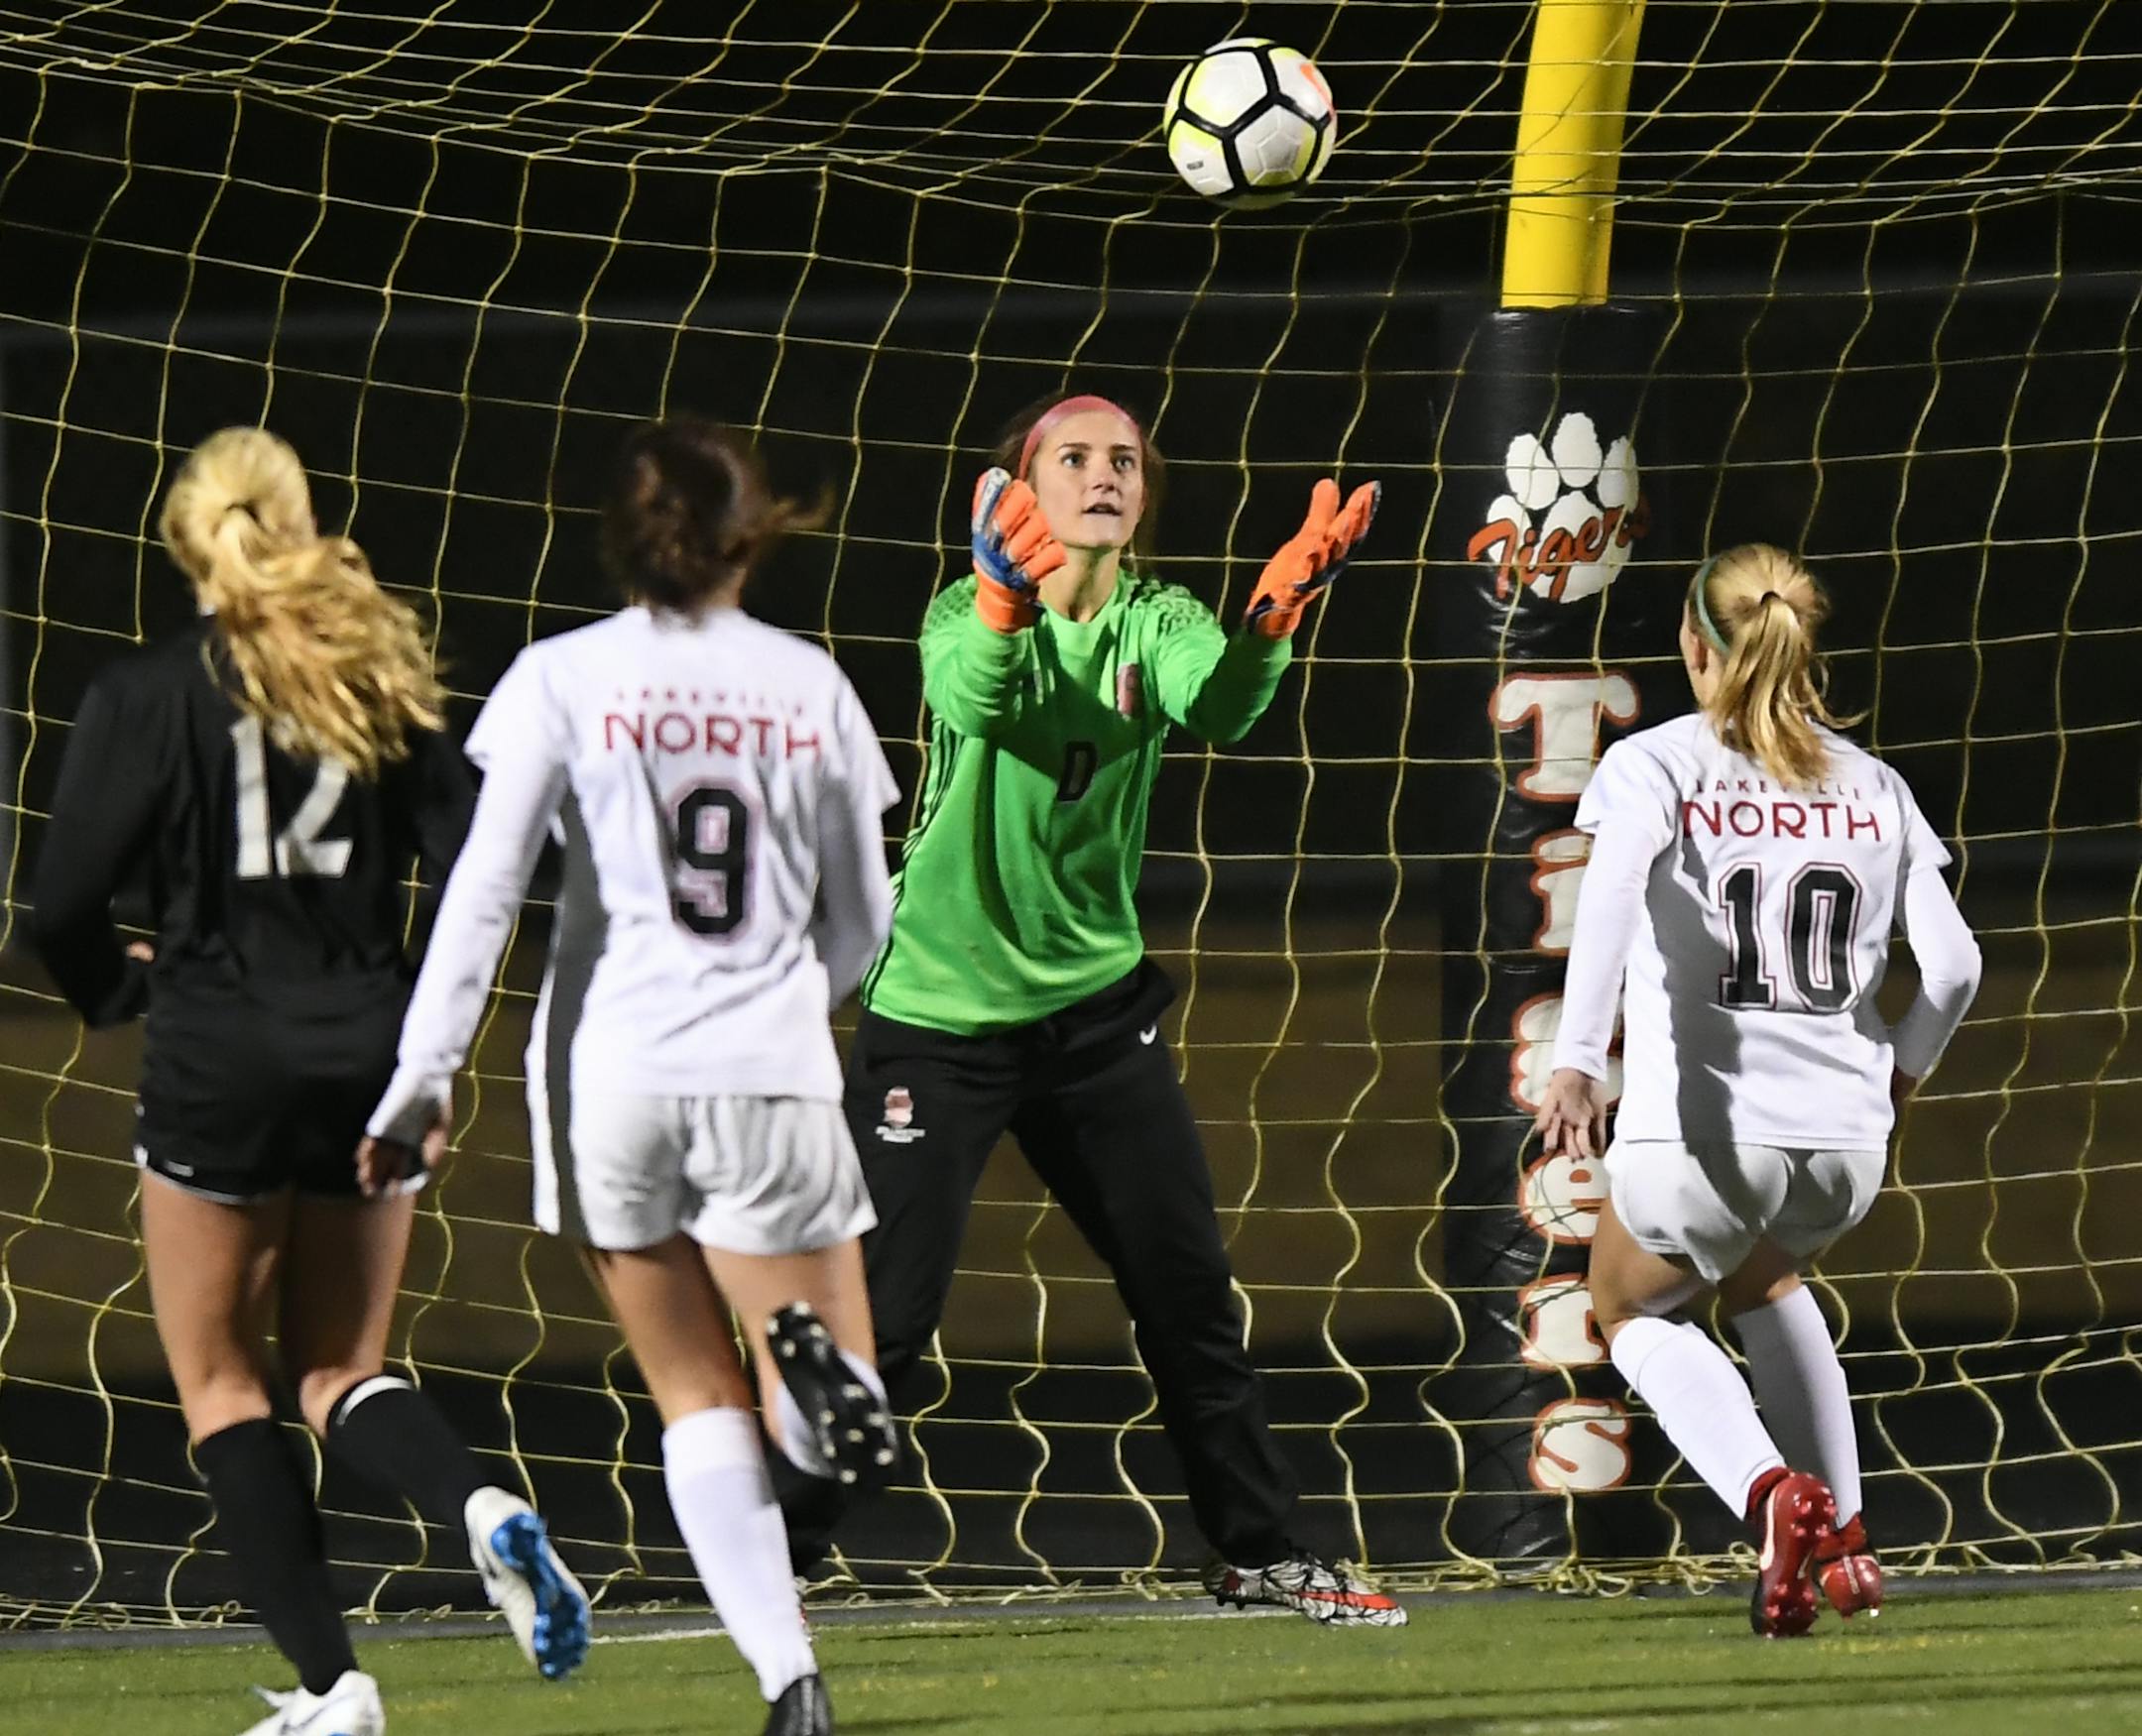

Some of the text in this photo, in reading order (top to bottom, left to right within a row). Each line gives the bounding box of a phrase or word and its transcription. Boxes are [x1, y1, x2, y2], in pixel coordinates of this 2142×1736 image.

[228, 712, 354, 879] 12
[606, 712, 822, 761] NORTH
[673, 783, 755, 940] 9
[1682, 800, 1881, 843] NORTH
[1719, 862, 1862, 1014] 10
